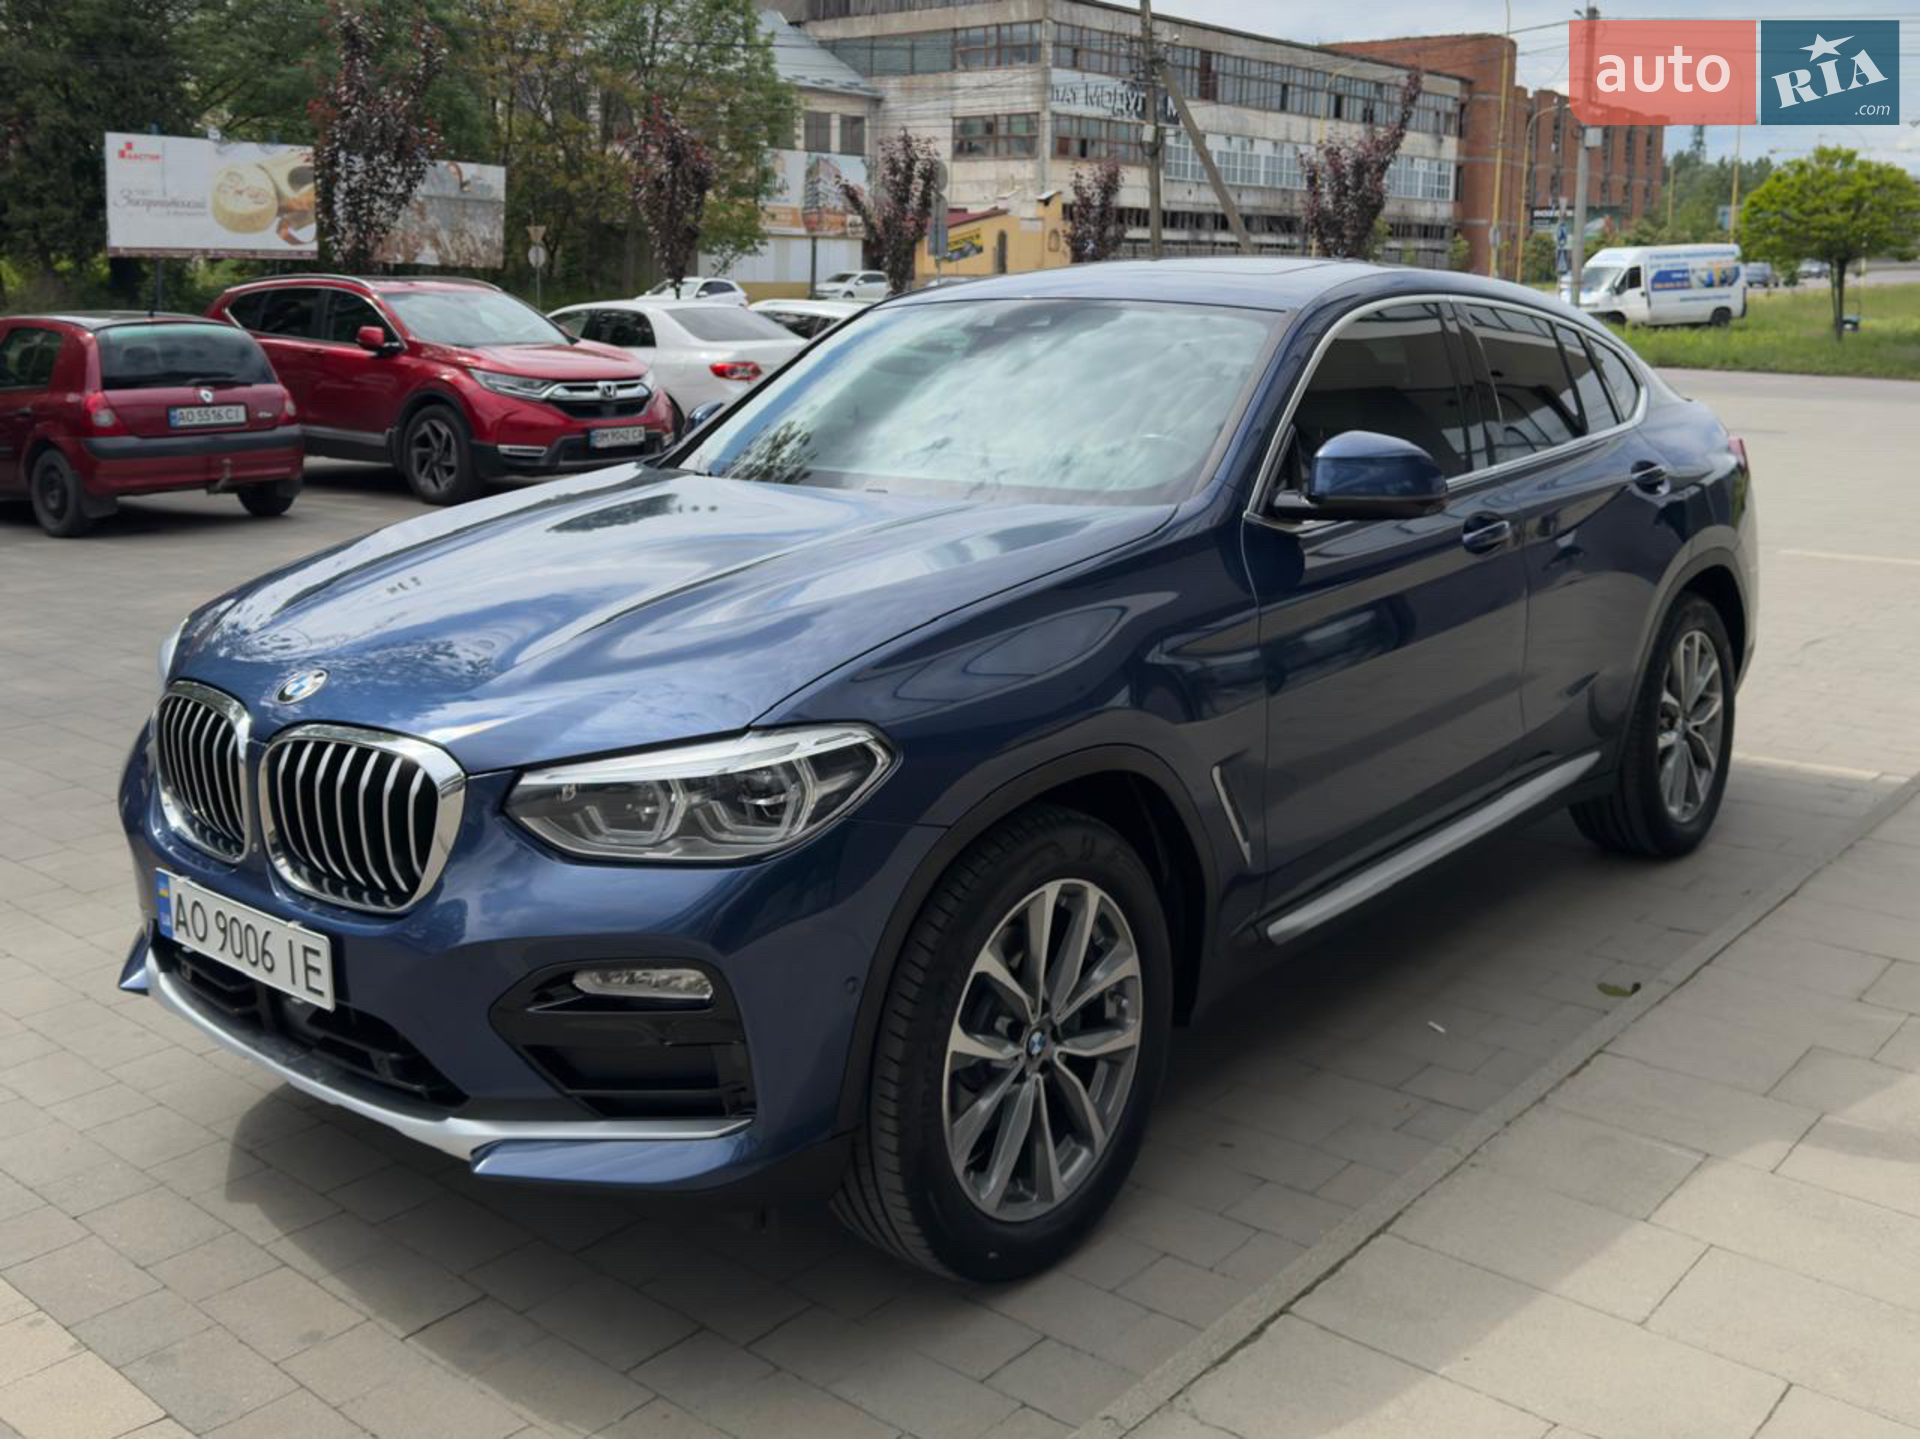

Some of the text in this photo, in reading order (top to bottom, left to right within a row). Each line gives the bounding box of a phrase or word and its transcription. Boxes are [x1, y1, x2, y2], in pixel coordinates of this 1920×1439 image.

[174, 892, 325, 998] AO 9006 IE
